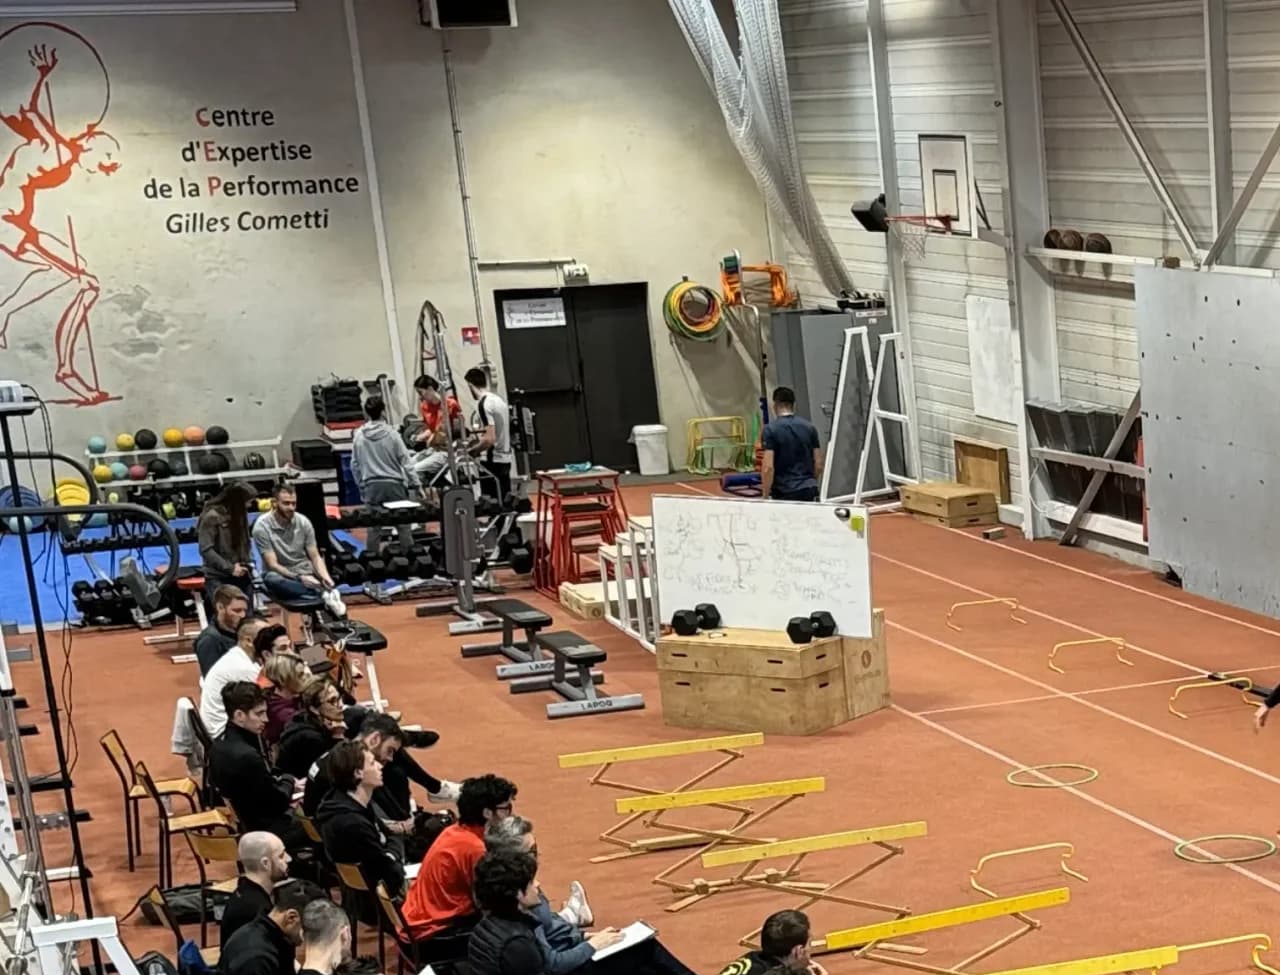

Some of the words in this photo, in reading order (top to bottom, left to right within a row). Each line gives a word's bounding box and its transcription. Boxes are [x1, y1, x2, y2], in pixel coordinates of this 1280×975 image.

[195, 107, 275, 128] Centre
[181, 140, 313, 167] d'Expertise
[143, 178, 173, 199] de
[179, 177, 201, 198] la
[207, 174, 359, 197] Performance
[166, 212, 230, 234] Gilles
[237, 208, 329, 231] Cometti
